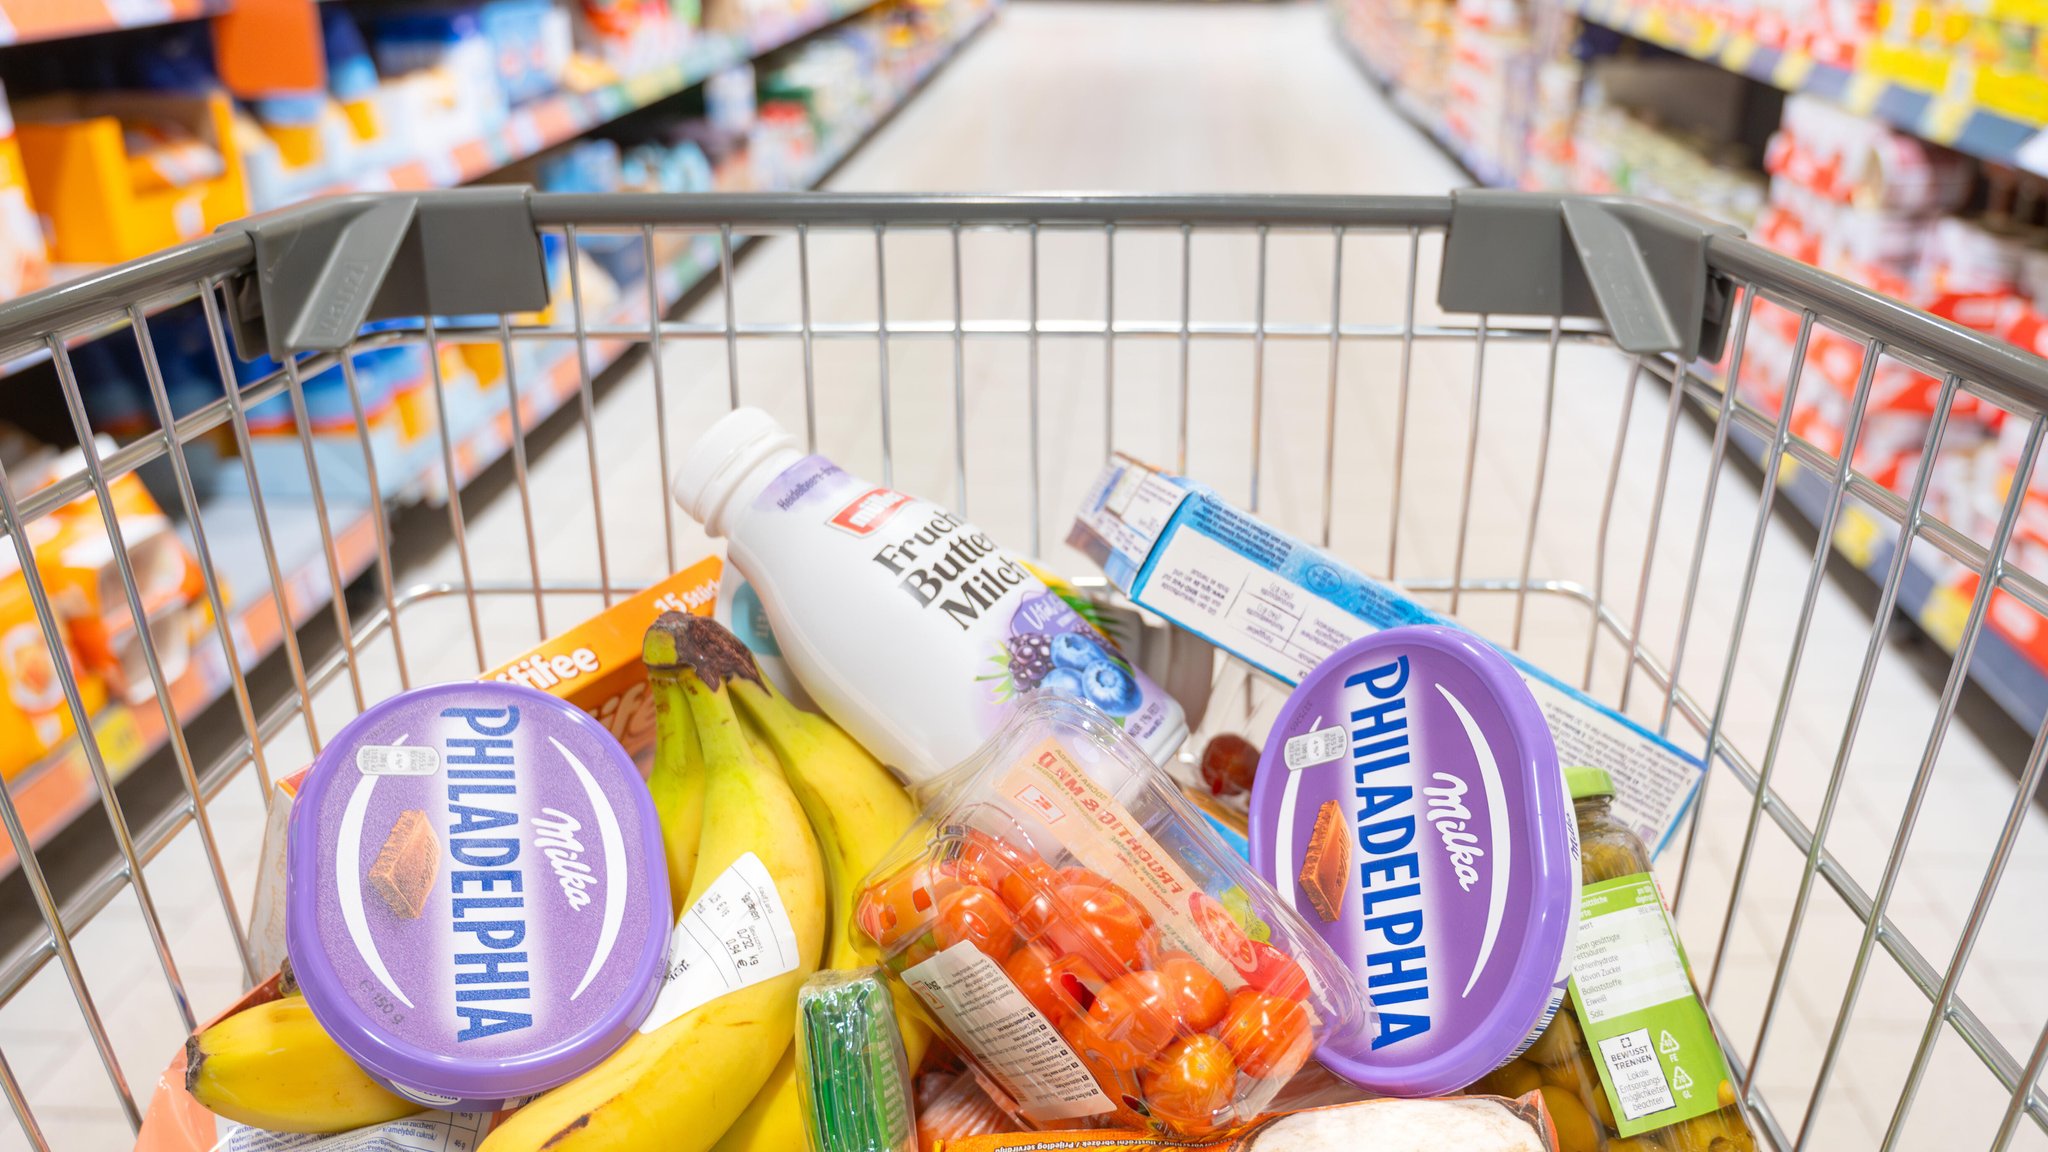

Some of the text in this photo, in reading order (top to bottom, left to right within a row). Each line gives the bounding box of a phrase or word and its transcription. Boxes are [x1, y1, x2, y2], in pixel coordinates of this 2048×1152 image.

[873, 510, 964, 577] Fruch
[653, 590, 690, 614] 15
[940, 560, 1031, 631] Milch
[495, 645, 599, 691] ffifee
[1423, 772, 1484, 892] Milka
[531, 807, 598, 911] Milka
[1344, 655, 1431, 1050] PHILADELPHIA
[440, 705, 533, 1042] PHILADELPHIA
[1579, 894, 1608, 908] nittliche
[734, 957, 748, 970] €
[746, 953, 762, 967] kg
[1579, 965, 1622, 983] davon Zucker
[370, 989, 406, 1026] 150 g
[1610, 1044, 1649, 1062] BEWUSST
[1613, 1053, 1653, 1070] TRENNEN
[1618, 1075, 1664, 1094] Entsorgungs-
[1626, 1068, 1649, 1081] Lokale
[1621, 1084, 1669, 1104] möglichkeiten
[1631, 1095, 1665, 1111] beachten
